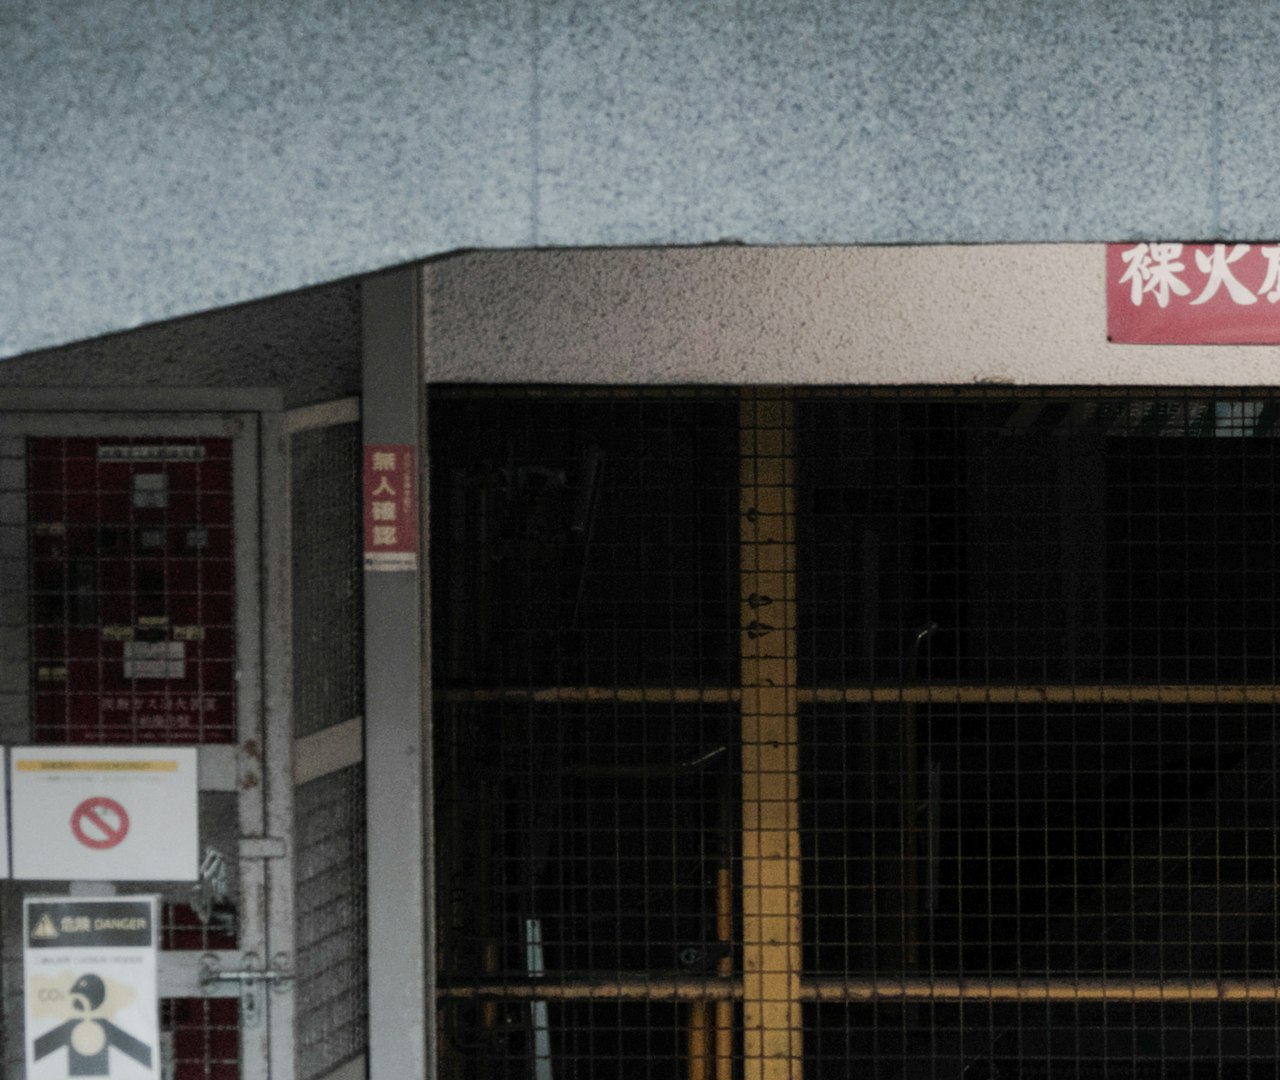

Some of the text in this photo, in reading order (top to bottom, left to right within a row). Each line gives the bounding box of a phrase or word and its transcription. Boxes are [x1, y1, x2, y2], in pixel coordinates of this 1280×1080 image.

[371, 452, 398, 546] 無人確認
[60, 915, 146, 933] 危険 DANGER
